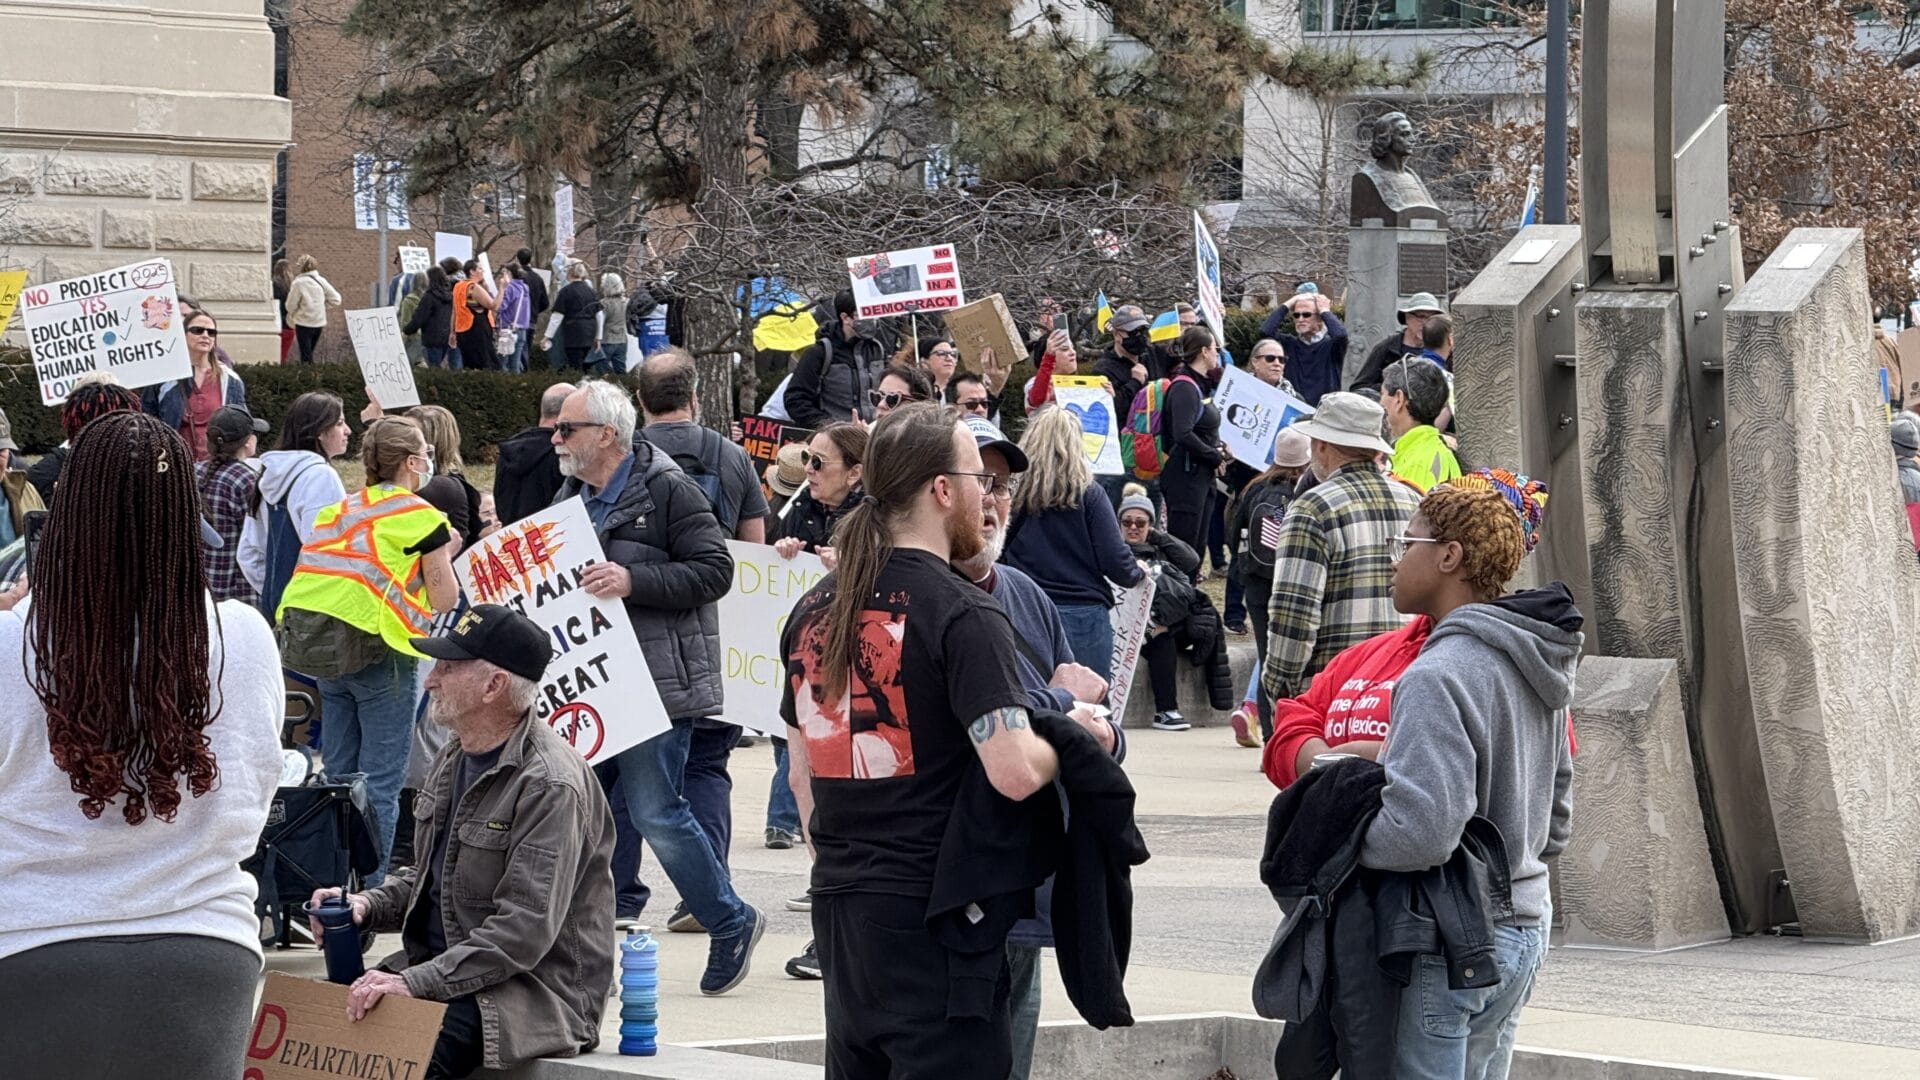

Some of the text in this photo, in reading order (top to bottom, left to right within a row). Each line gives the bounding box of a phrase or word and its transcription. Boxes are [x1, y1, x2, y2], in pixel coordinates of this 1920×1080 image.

[935, 248, 949, 257] NO
[25, 289, 49, 308] NO
[60, 271, 127, 300] PROJECT
[132, 263, 167, 283] 2025
[927, 279, 956, 290] IN A
[79, 296, 107, 316] YES
[861, 297, 957, 316] DEMOCRACY
[31, 310, 120, 345] EDUCATION
[367, 315, 396, 340] THE
[34, 333, 96, 361] SCIENCE
[38, 340, 165, 382] HUMAN RIGHTS
[44, 377, 80, 401] LOV
[742, 416, 779, 440] TAK
[471, 527, 550, 602] HATE
[535, 558, 597, 608] MAK
[1111, 581, 1152, 722] STOP PROJECT 2025
[727, 647, 786, 689] DICT
[535, 652, 610, 718] GREAT
[556, 713, 591, 741] HATE
[247, 1003, 418, 1080] DEPARTMENT
